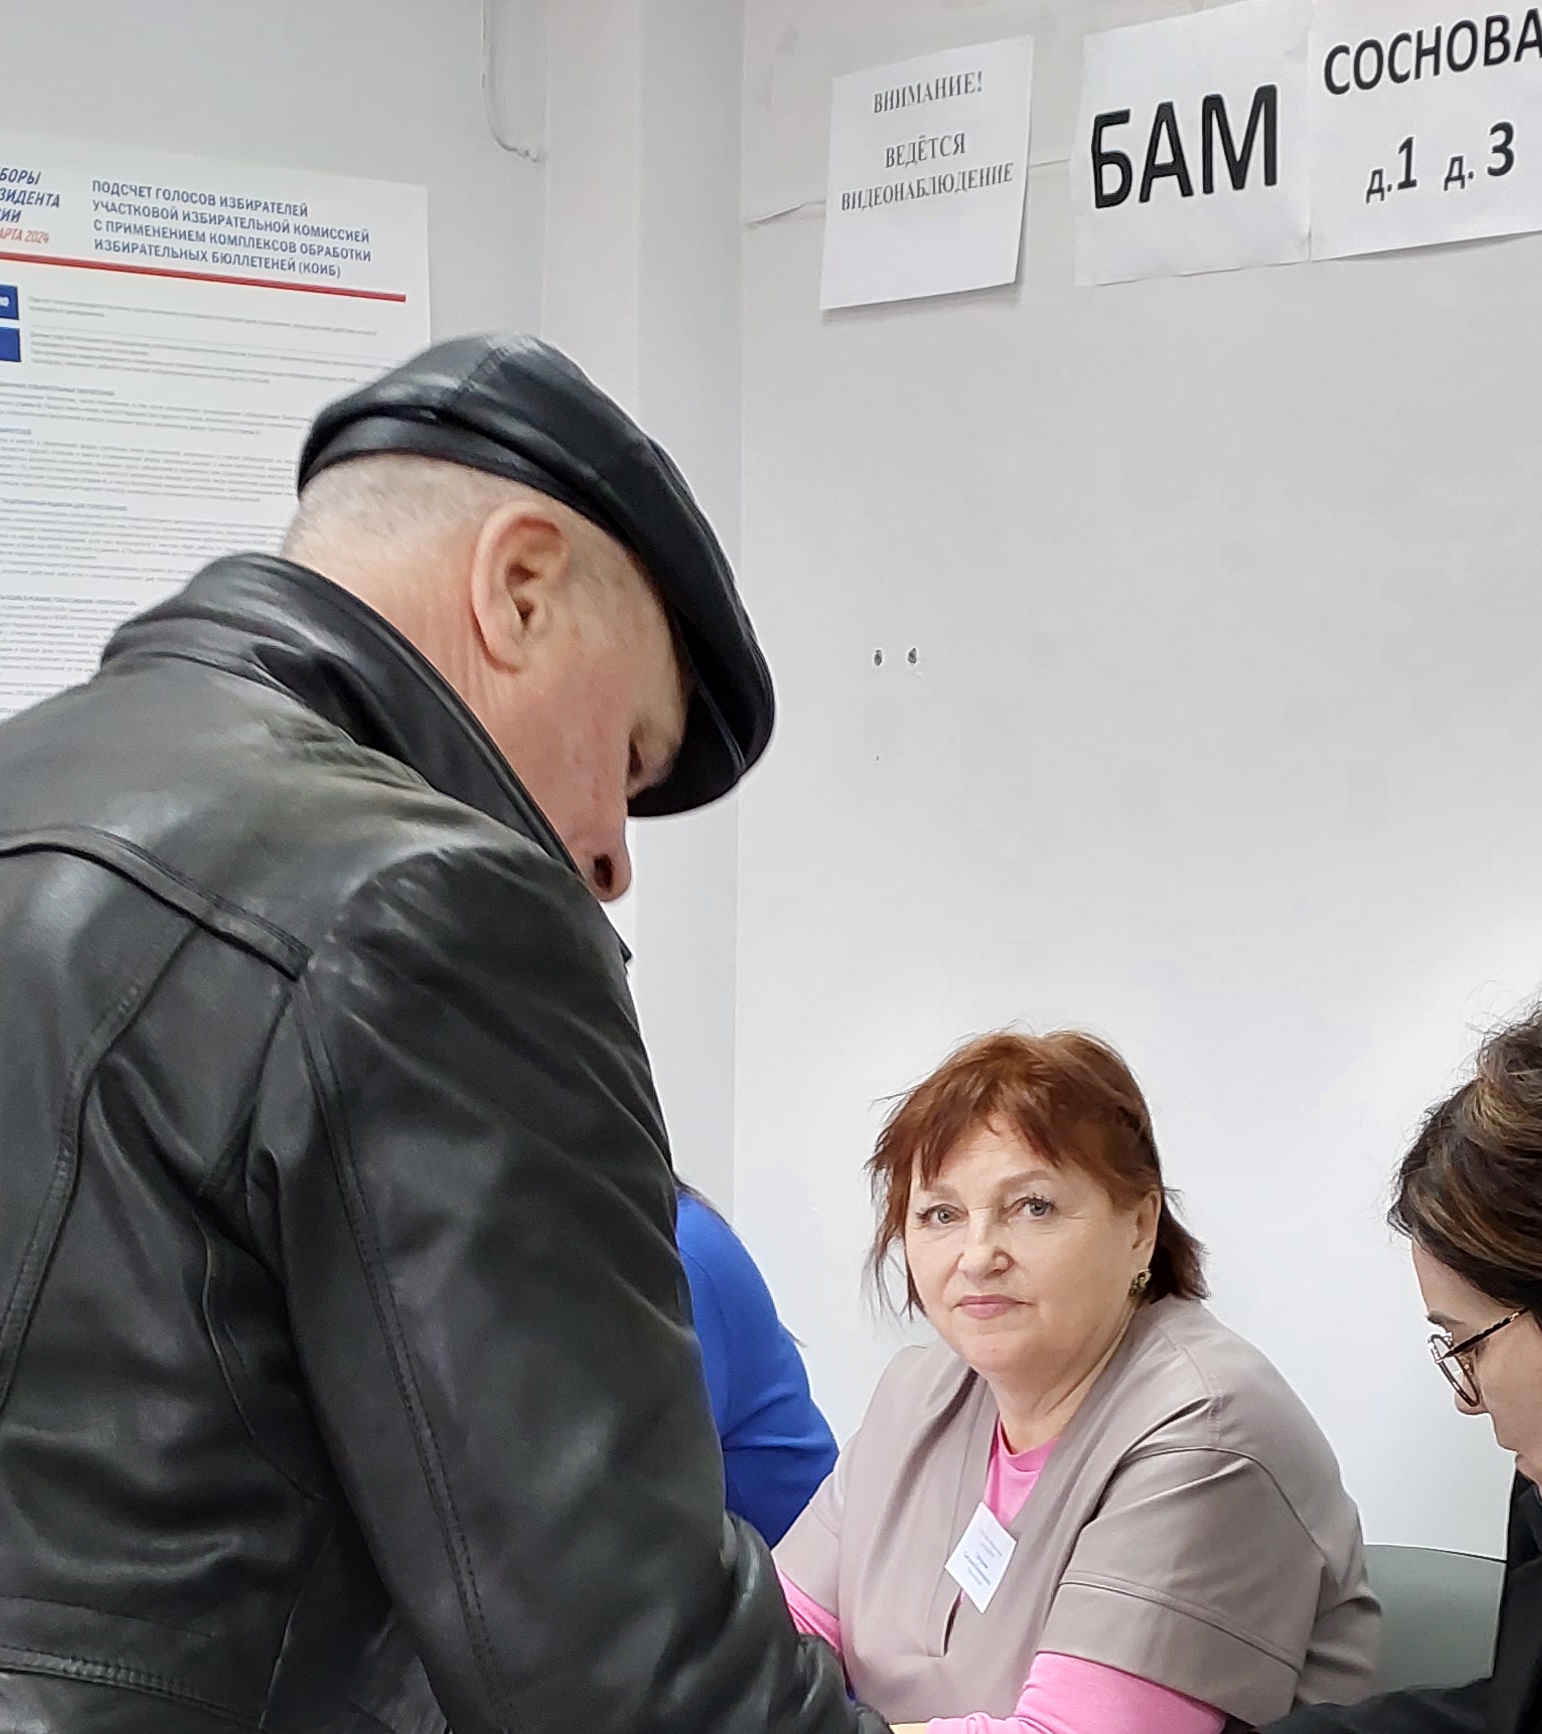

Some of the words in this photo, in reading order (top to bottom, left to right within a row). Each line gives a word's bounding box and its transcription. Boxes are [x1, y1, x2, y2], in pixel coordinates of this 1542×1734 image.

[873, 70, 983, 114] ВНИМАНИЕ!
[884, 132, 966, 168] ВЕДЁТСЯ
[1090, 83, 1278, 209] БАМ
[1486, 121, 1515, 176] 3
[92, 180, 152, 198] ПОДСЧЕТ
[155, 187, 216, 206] ГОЛОСОВ
[219, 195, 308, 217] ИЗБИРАТЕЛЕЙ
[841, 162, 1014, 211] ВИДЕОНАБЛЮДЕНИЕ
[24, 230, 50, 244] 2024
[92, 199, 179, 221] УЧАСТКОВОЙ
[182, 210, 290, 234] ИЗБИРАТЕЛЬНОЙ
[293, 223, 370, 243] КОМИССИЕЙ
[93, 219, 103, 232] С
[105, 220, 206, 243] ПРИМЕНЕНИЕМ
[209, 232, 297, 254] КОМПЛЕКСОВ
[300, 242, 371, 262] ОБРАБОТКИ
[94, 238, 208, 262] ИЗБИРАТЕЛЬНЫХ
[211, 251, 296, 272] БЮЛЛЕТЕНЕЙ
[299, 261, 341, 279] (КОИБ)
